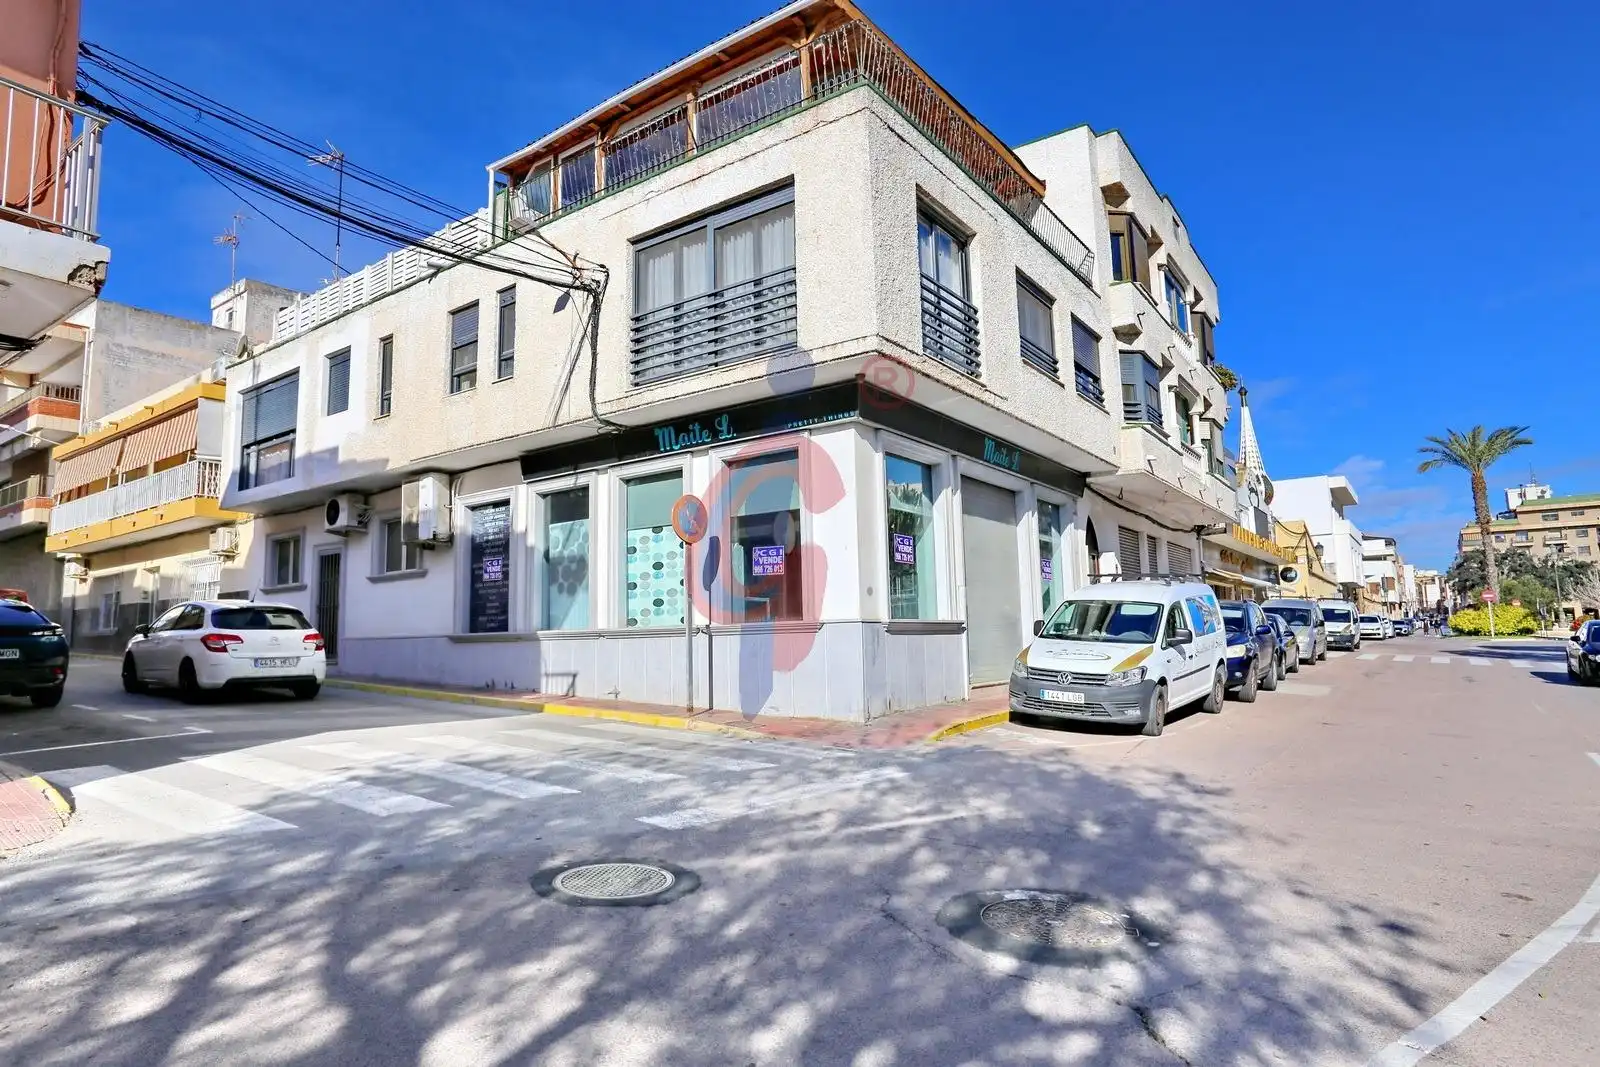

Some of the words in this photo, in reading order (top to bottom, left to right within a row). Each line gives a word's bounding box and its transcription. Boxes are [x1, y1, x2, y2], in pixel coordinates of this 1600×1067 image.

[653, 422, 712, 451] Maite
[983, 437, 1009, 468] Maite
[759, 556, 783, 565] VENDE
